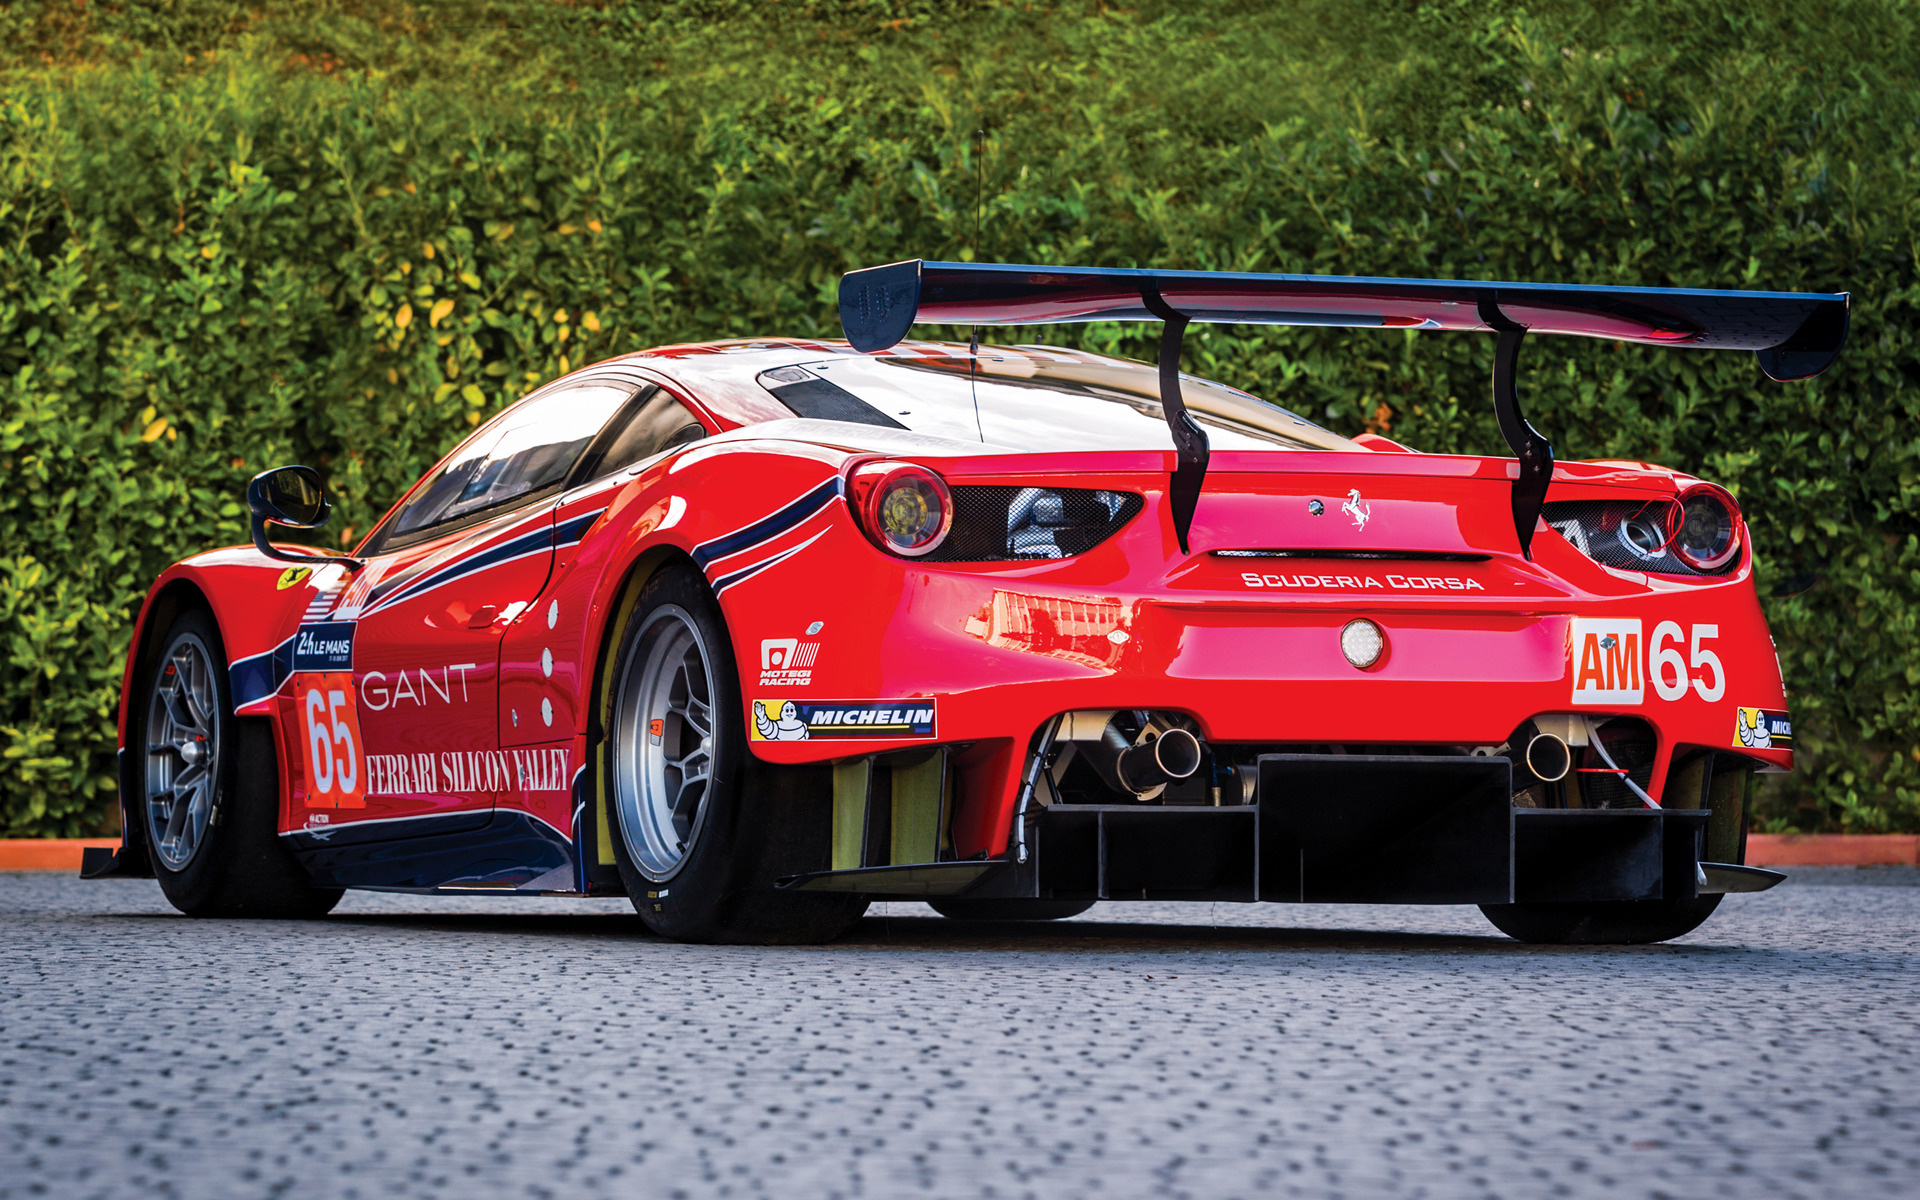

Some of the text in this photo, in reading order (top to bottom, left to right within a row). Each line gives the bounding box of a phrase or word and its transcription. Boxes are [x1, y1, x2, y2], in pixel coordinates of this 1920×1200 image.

[1241, 572, 1485, 590] SCUDERIA CORSA
[325, 640, 350, 655] MANS
[1576, 633, 1640, 690] AM
[1649, 620, 1726, 703] 65
[361, 663, 476, 711] GANT
[759, 678, 811, 686] RACING
[760, 670, 812, 678] MOTEGI
[811, 709, 934, 725] MICHELIN
[306, 688, 357, 794] 65
[366, 749, 569, 795] FERRARI SILICON VALLEY
